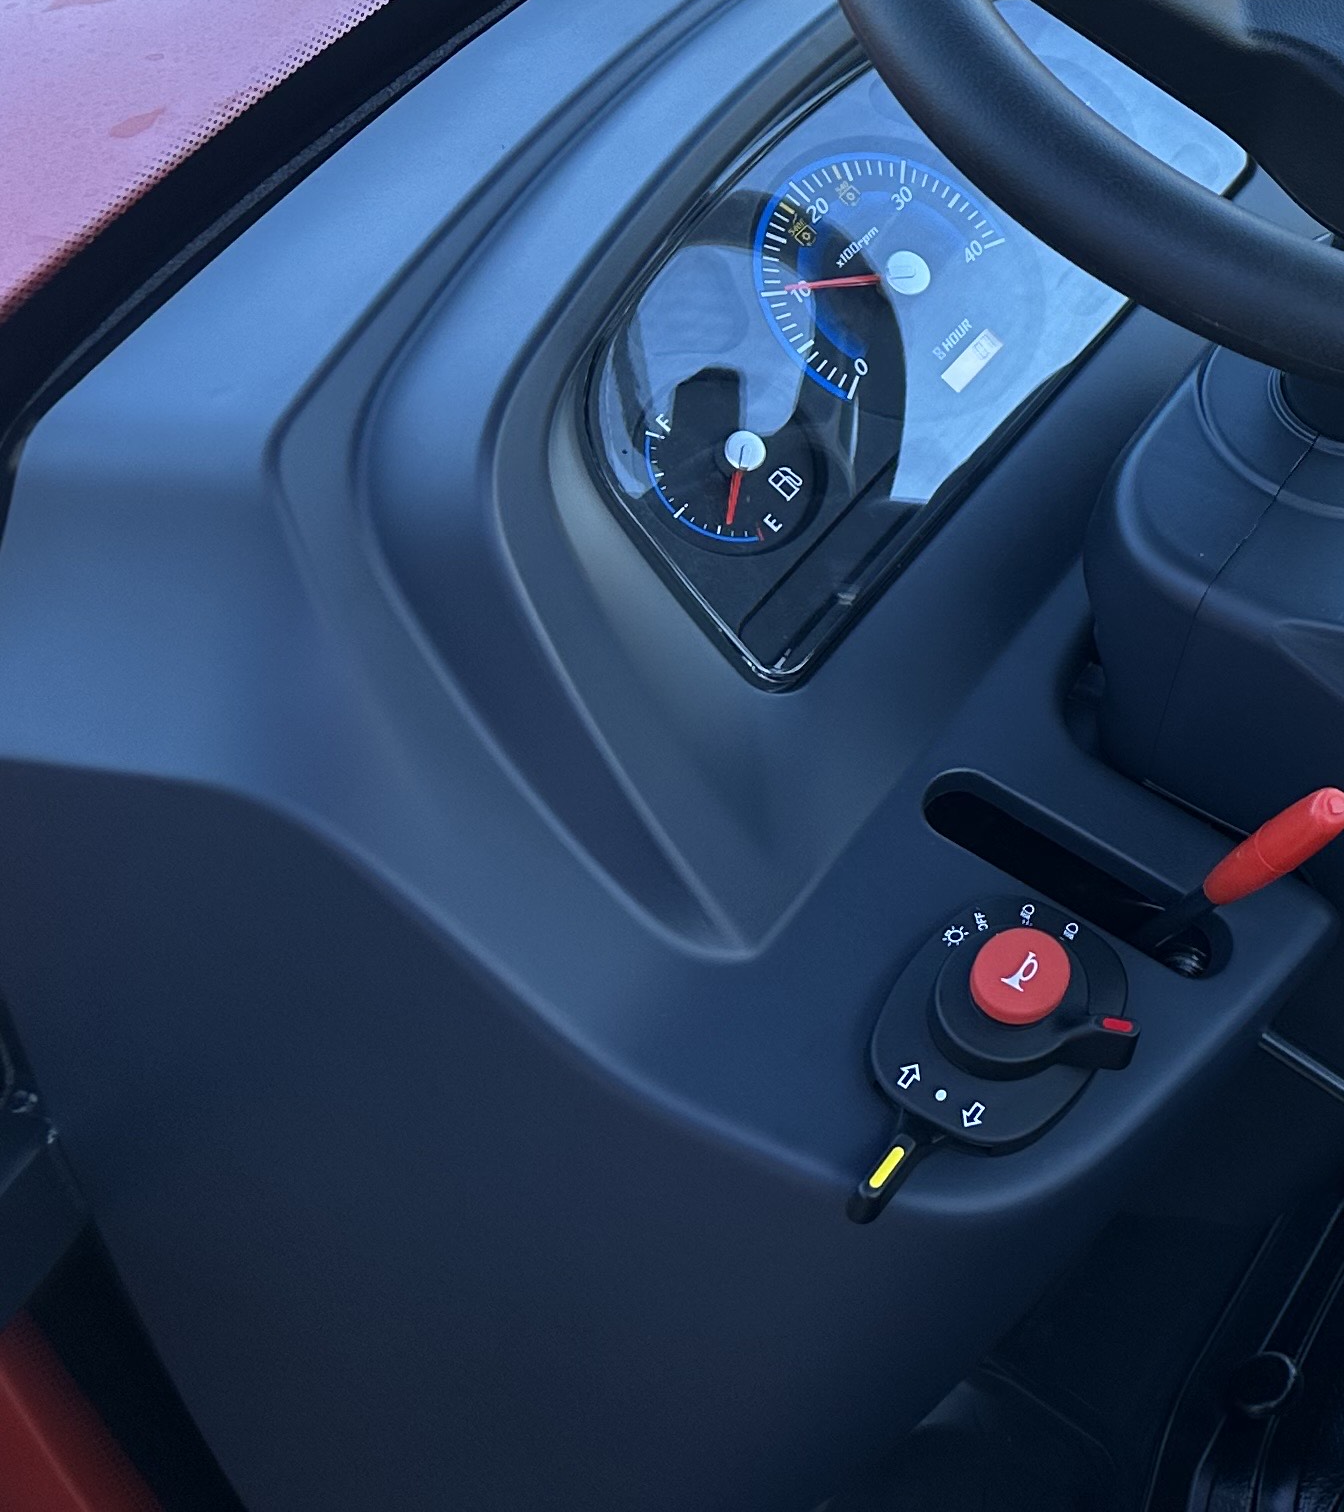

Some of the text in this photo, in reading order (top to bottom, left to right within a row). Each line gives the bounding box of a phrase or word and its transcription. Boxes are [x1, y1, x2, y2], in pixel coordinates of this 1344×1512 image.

[806, 197, 828, 223] 20
[890, 186, 913, 211] 30
[964, 239, 984, 264] 40
[790, 280, 812, 303] 10
[941, 318, 972, 352] HOUR
[854, 358, 868, 375] 0
[655, 413, 671, 432] F
[763, 513, 783, 532] E
[974, 912, 989, 932] OFF
